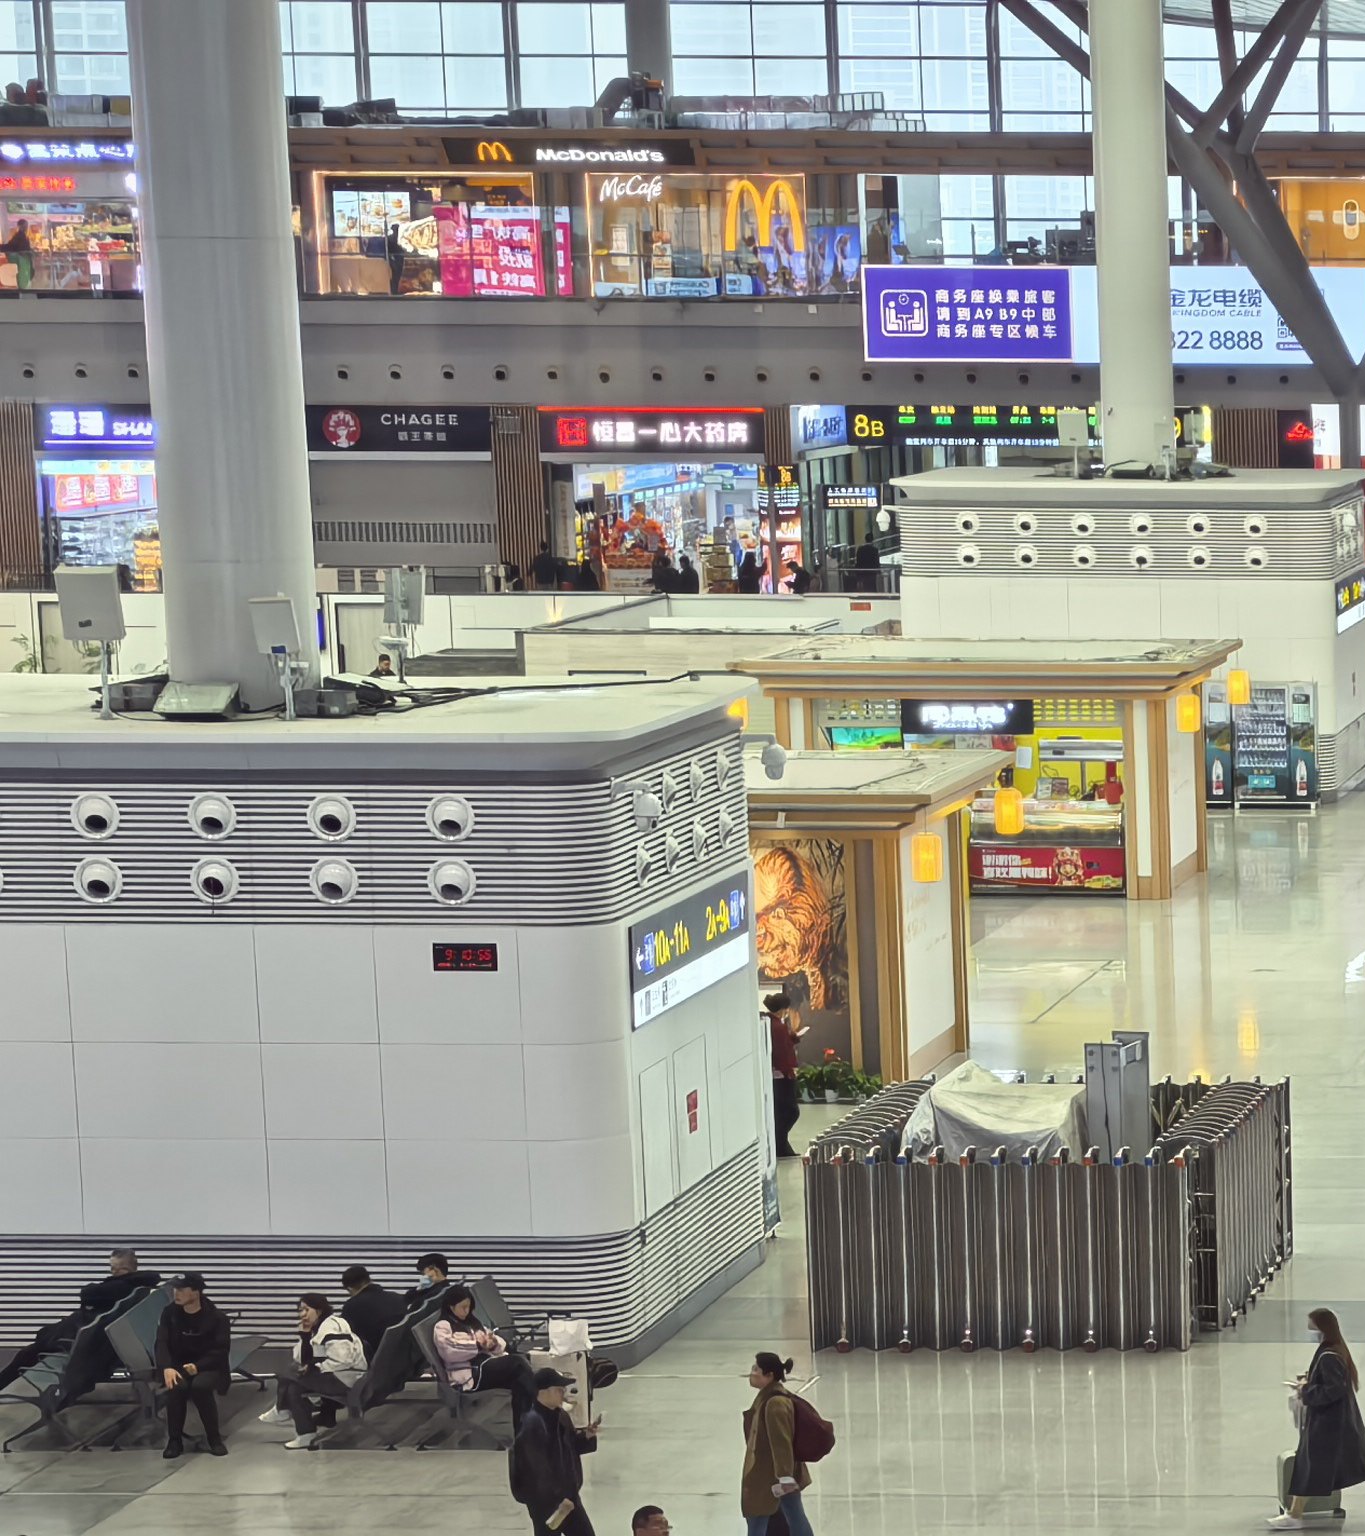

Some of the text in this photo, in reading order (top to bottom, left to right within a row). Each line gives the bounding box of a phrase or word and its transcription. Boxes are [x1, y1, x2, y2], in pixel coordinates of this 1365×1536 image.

[536, 148, 664, 162] McDonald's
[600, 174, 663, 202] McCafé
[935, 289, 1056, 304] 商务座换乘旅客
[936, 324, 1057, 339] 商务座专区候车
[1209, 330, 1263, 350] 8888
[380, 413, 459, 426] CHAGEE
[853, 413, 885, 437] 8B
